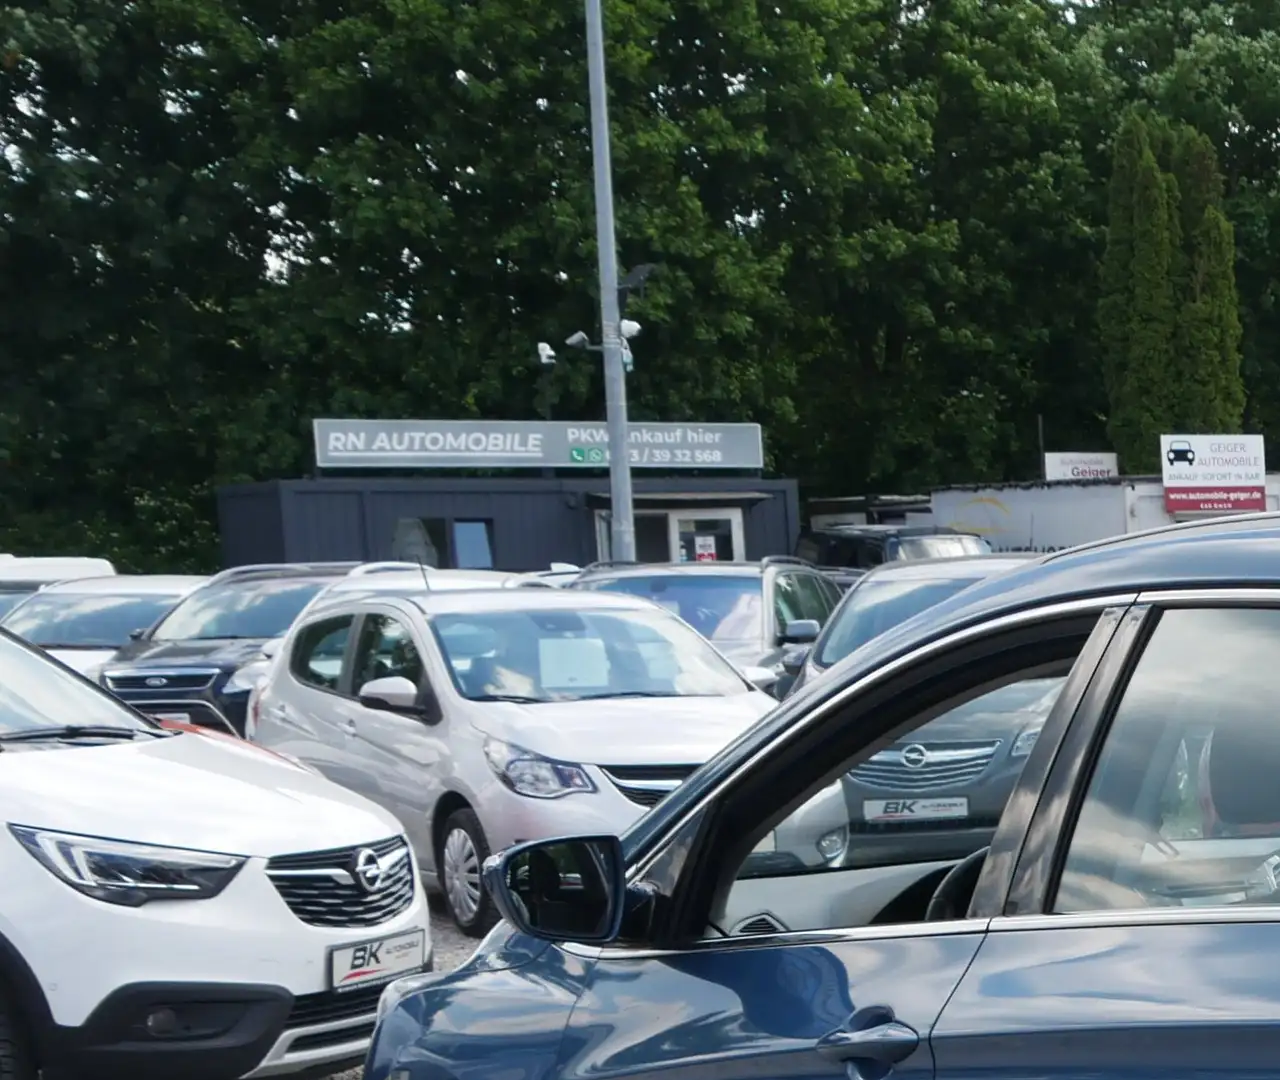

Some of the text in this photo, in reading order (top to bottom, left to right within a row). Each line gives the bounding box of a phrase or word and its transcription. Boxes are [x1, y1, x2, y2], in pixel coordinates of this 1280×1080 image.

[328, 431, 544, 452] RN AUTOMOBILE
[626, 428, 683, 443] nkauf
[687, 429, 722, 443] hier
[1210, 442, 1247, 453] GEIGER
[652, 449, 671, 463] 39
[674, 449, 692, 463] 32
[694, 449, 723, 463] 568
[1197, 456, 1260, 467] AUTOMOBILE
[883, 800, 918, 815] BK
[350, 942, 384, 970] BK
